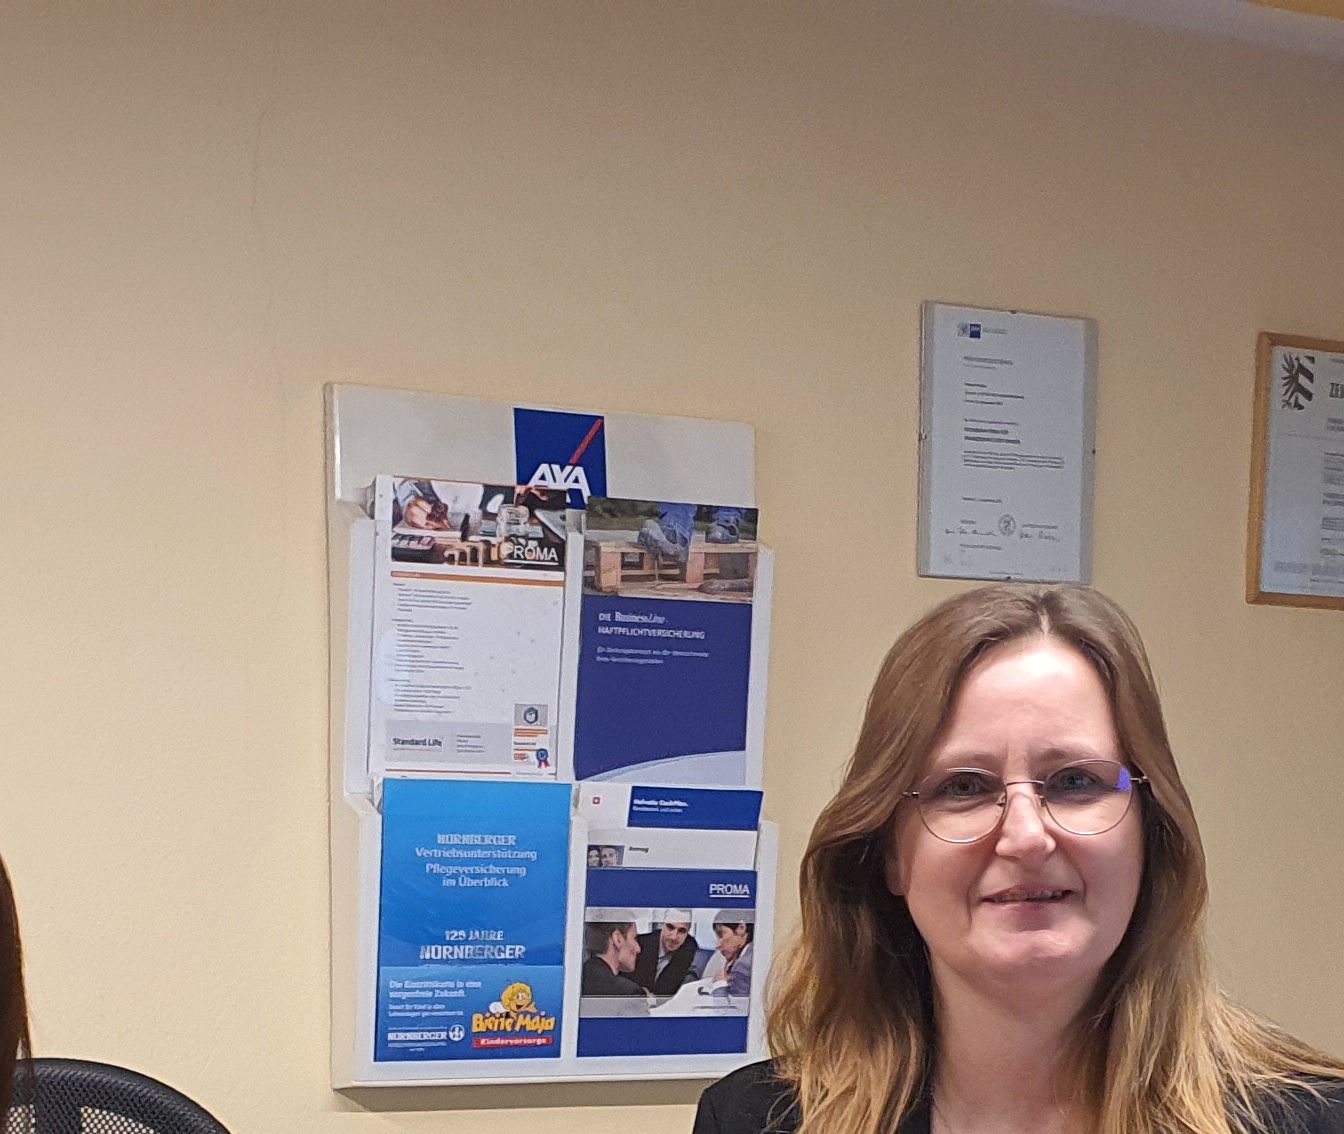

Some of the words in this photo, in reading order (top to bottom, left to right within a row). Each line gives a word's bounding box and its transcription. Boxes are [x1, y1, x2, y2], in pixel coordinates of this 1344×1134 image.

[526, 463, 591, 504] AXA
[393, 737, 427, 747] Standard
[428, 738, 442, 748] Life
[426, 863, 527, 877] Pflegeversicherung
[458, 875, 510, 887] Überblick
[709, 883, 751, 895] PROMA
